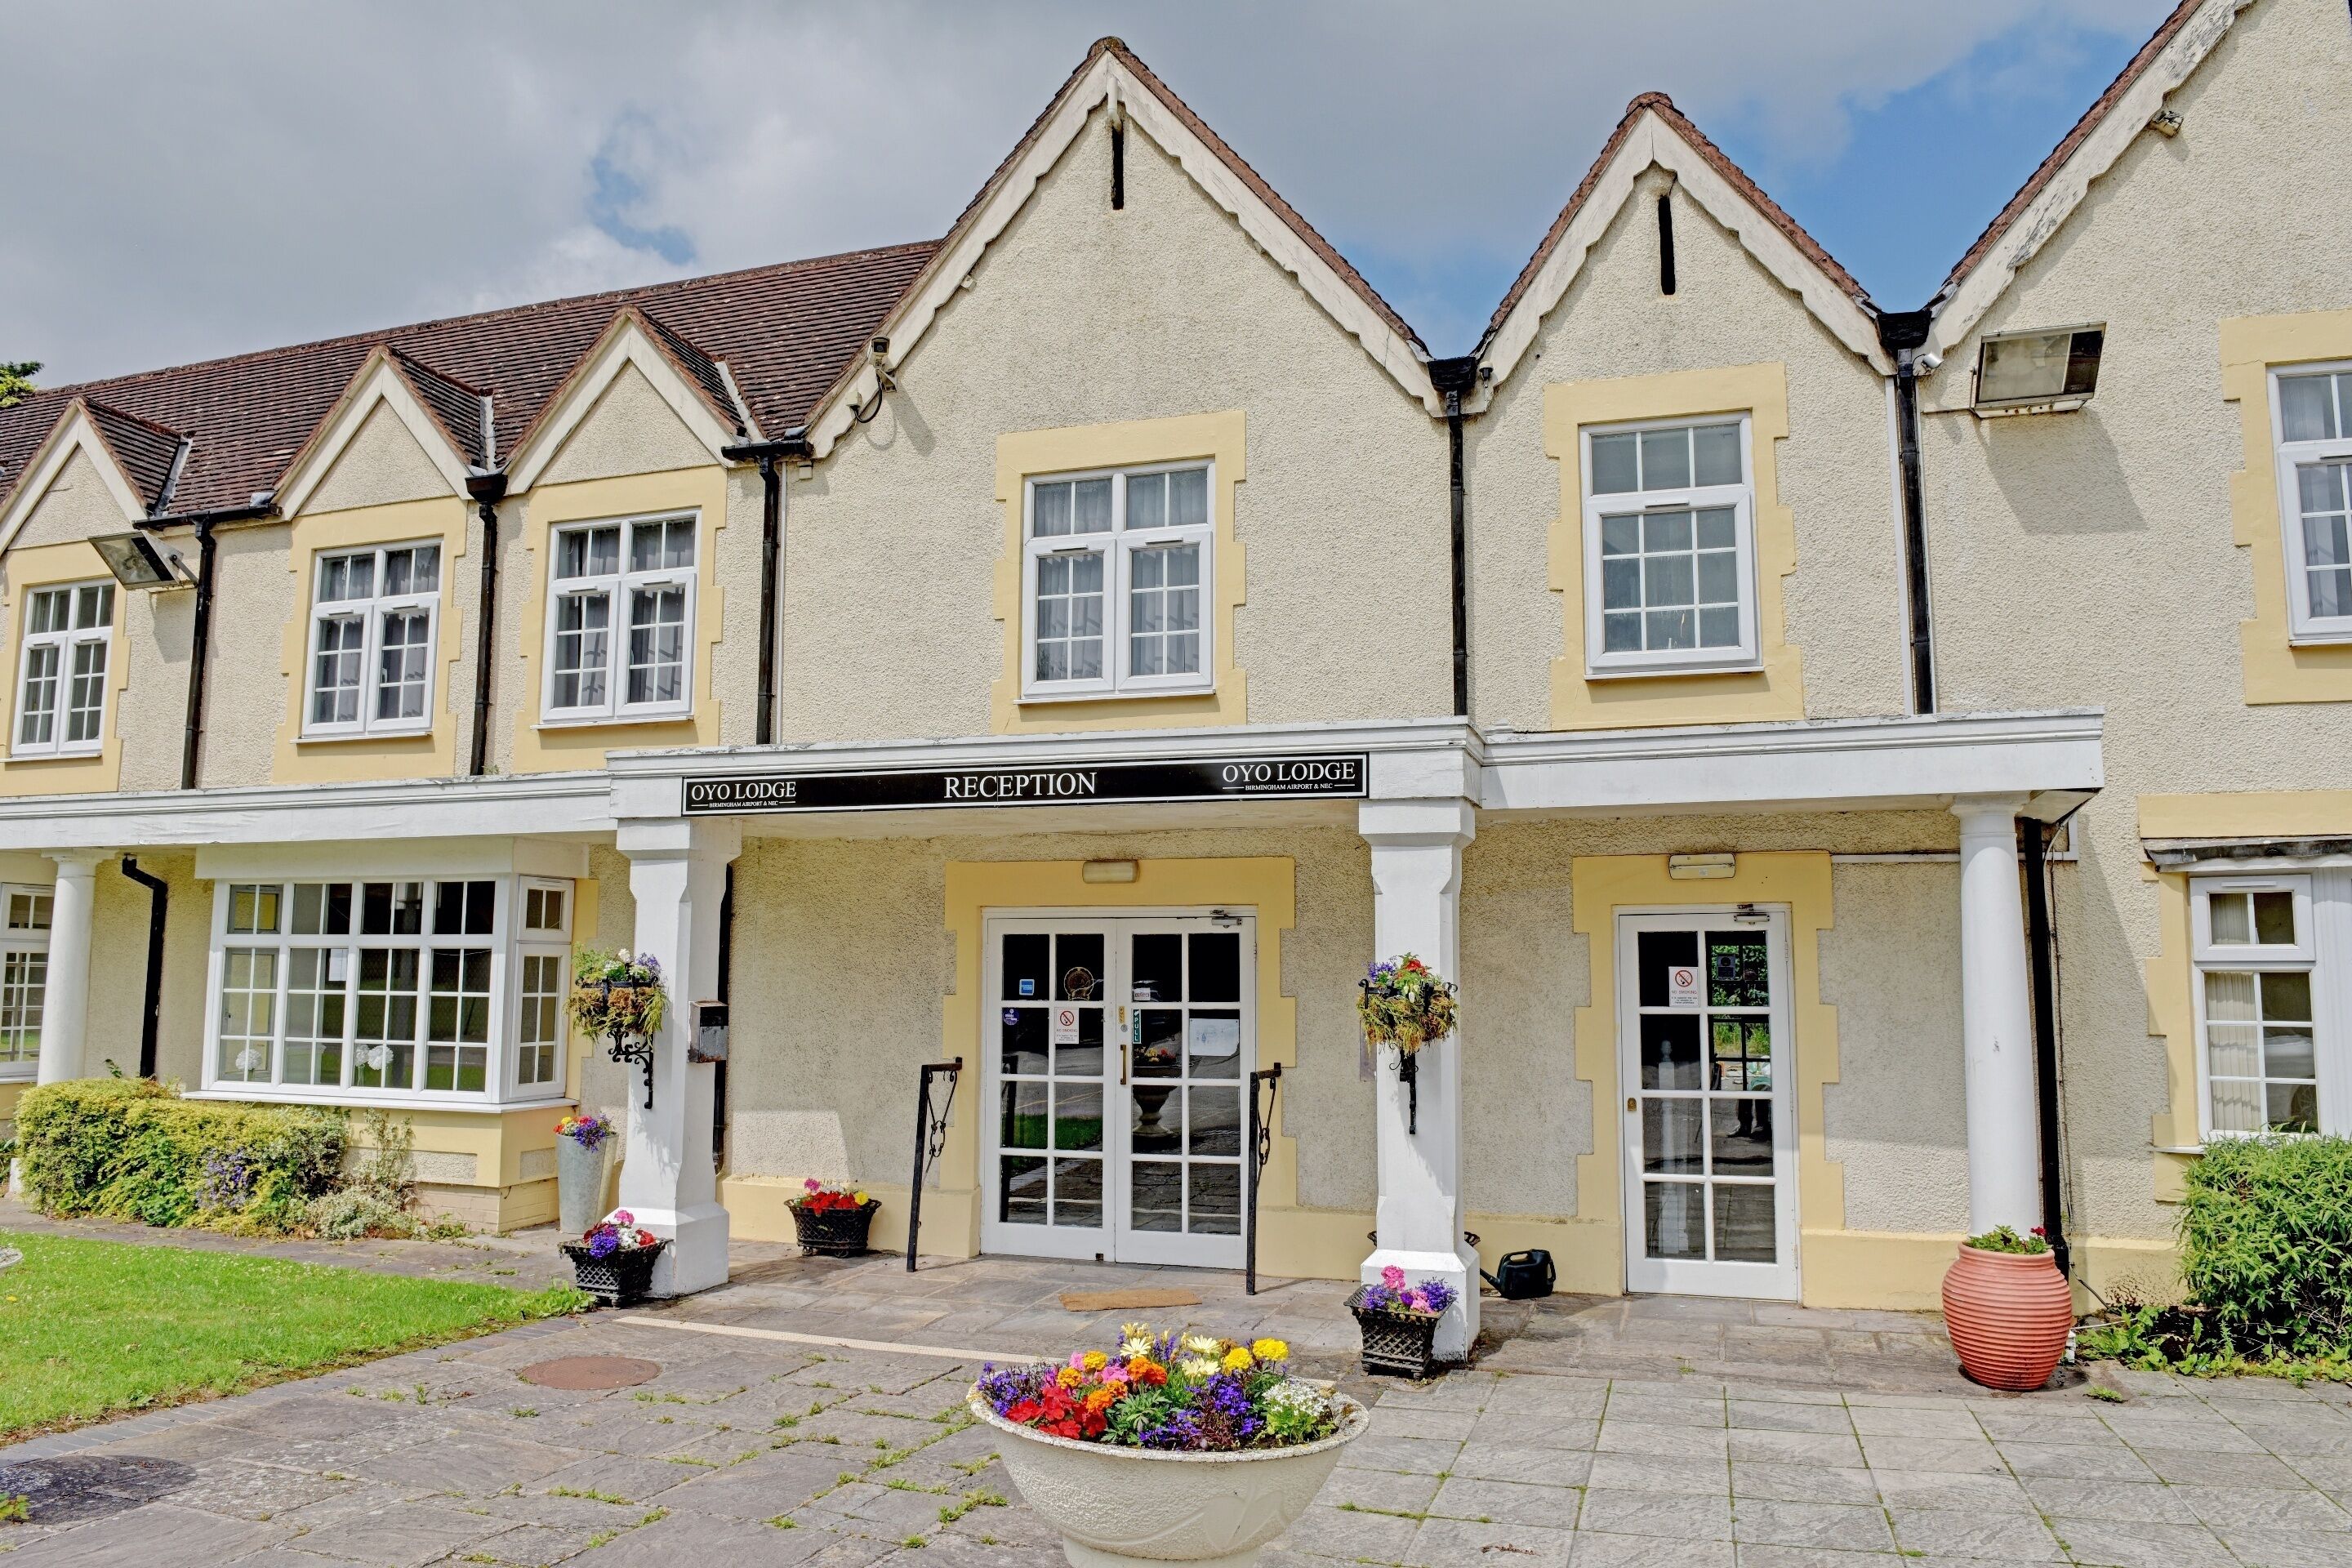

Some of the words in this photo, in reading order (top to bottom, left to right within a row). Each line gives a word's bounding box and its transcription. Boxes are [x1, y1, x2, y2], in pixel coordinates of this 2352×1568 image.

[1223, 764, 1272, 782] OYO
[1276, 762, 1356, 782] LODGE
[691, 784, 731, 800] OYO
[734, 782, 797, 800] LODGE
[943, 772, 1098, 799] RECEPTION
